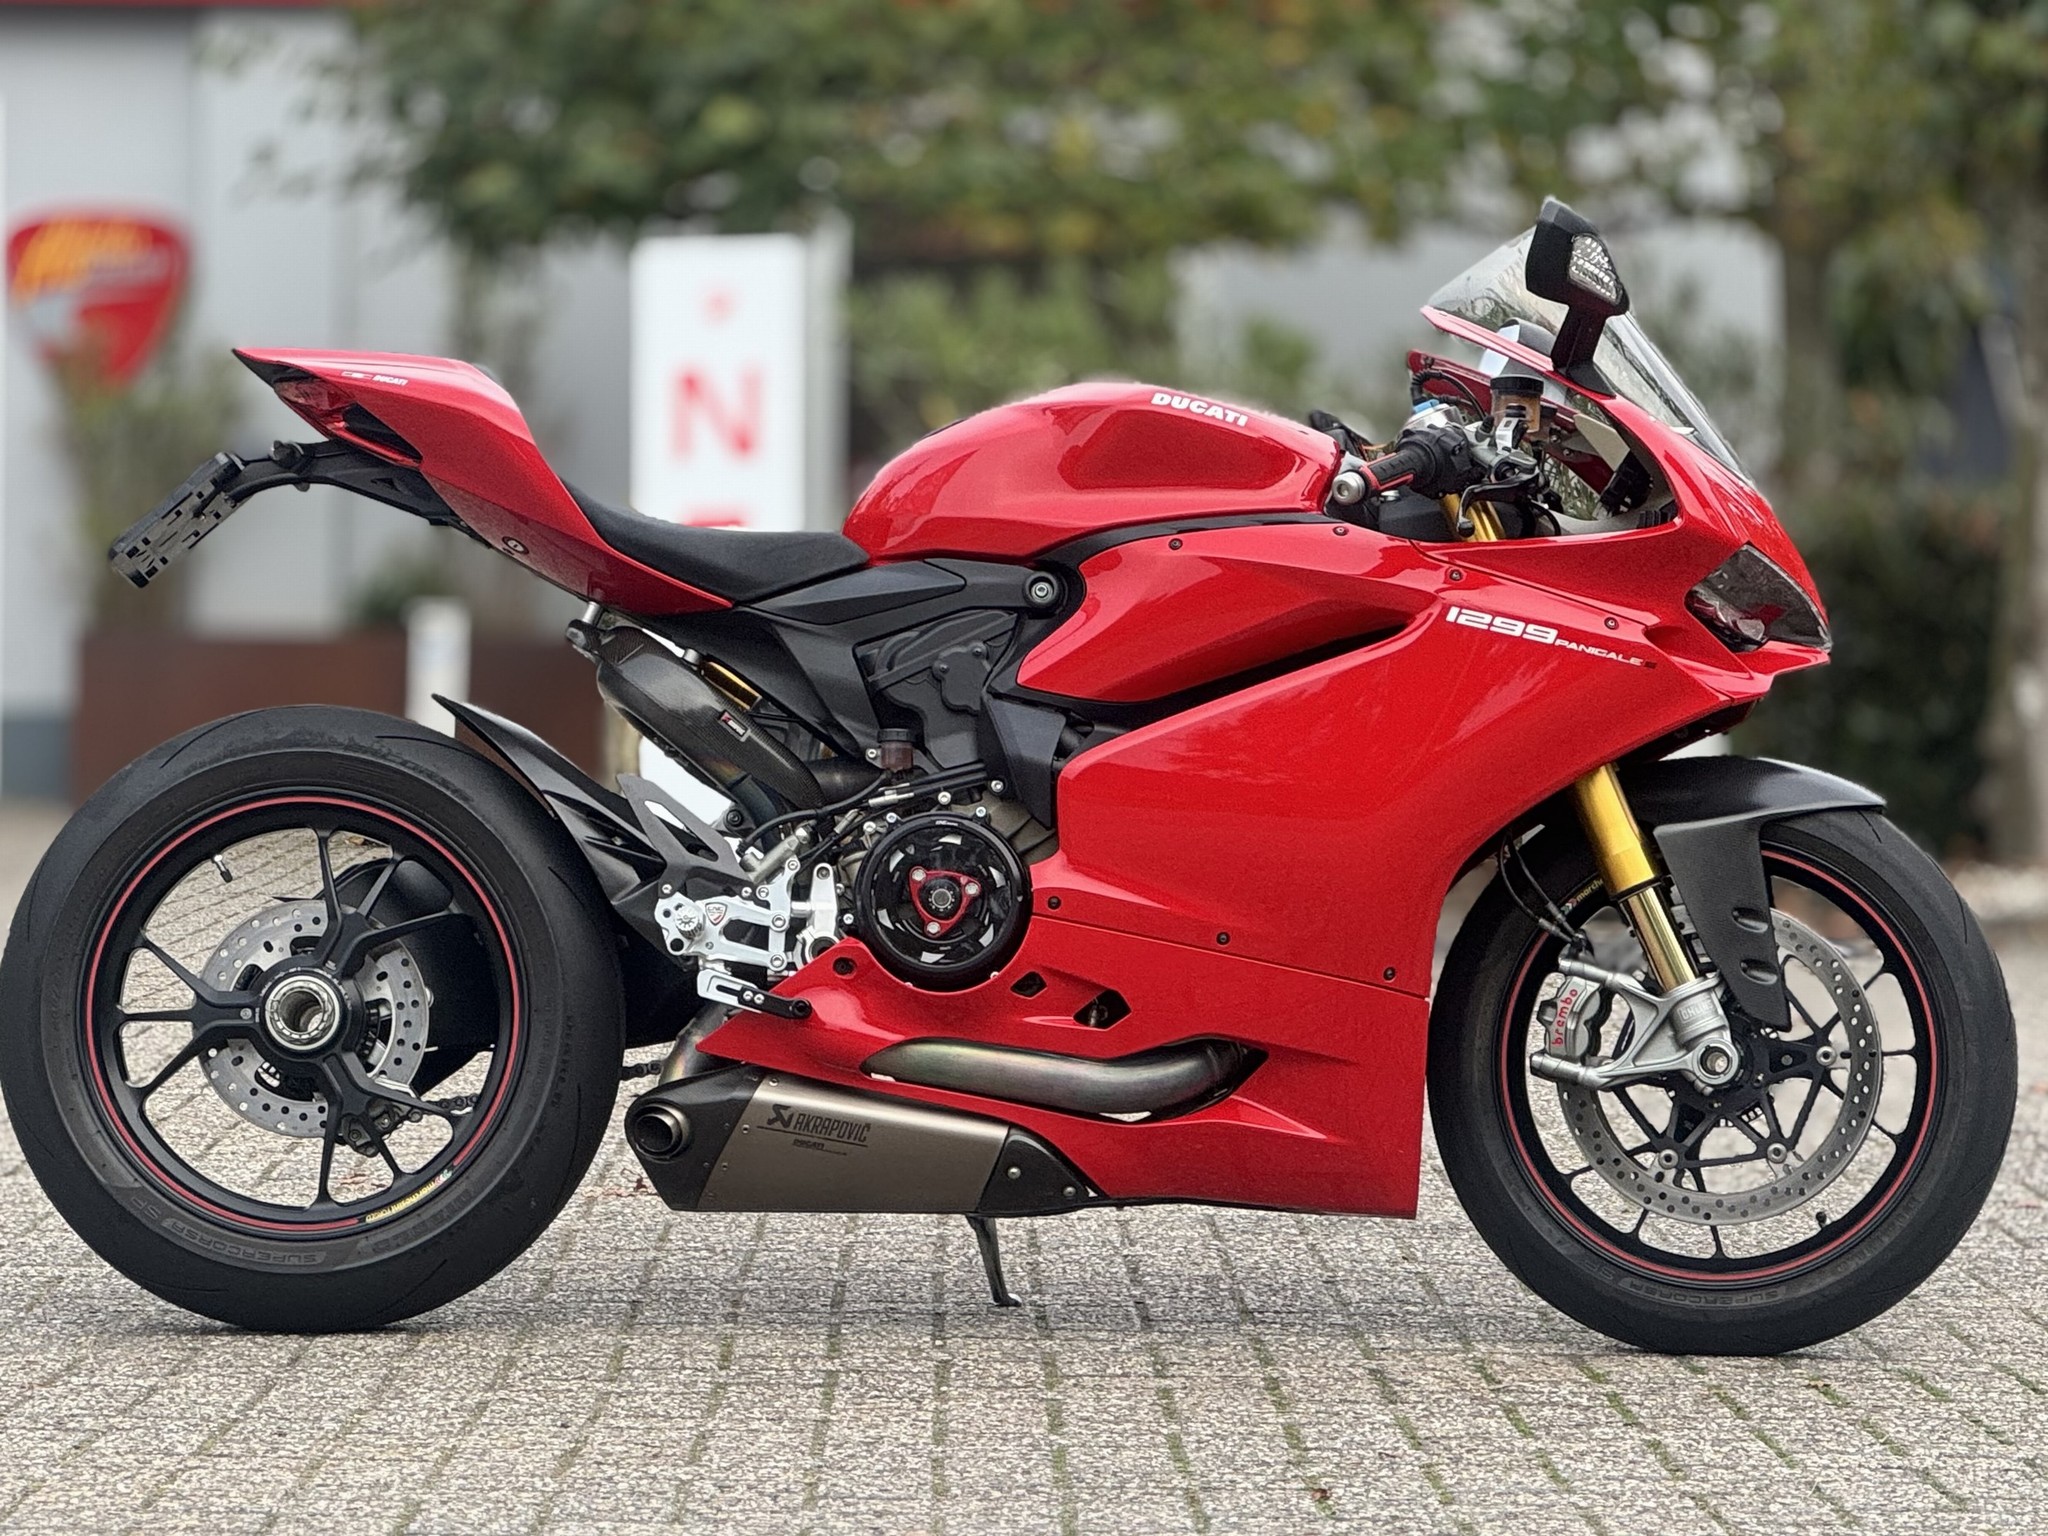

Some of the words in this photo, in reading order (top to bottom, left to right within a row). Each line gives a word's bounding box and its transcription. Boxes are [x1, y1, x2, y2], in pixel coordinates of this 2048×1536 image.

[1151, 392, 1249, 427] DUCATI
[1446, 606, 1558, 645] 1299
[1552, 989, 1578, 1047] brembo
[171, 1221, 317, 1264] SUPERCORSA
[1628, 1279, 1779, 1306] SUPERCORSA
